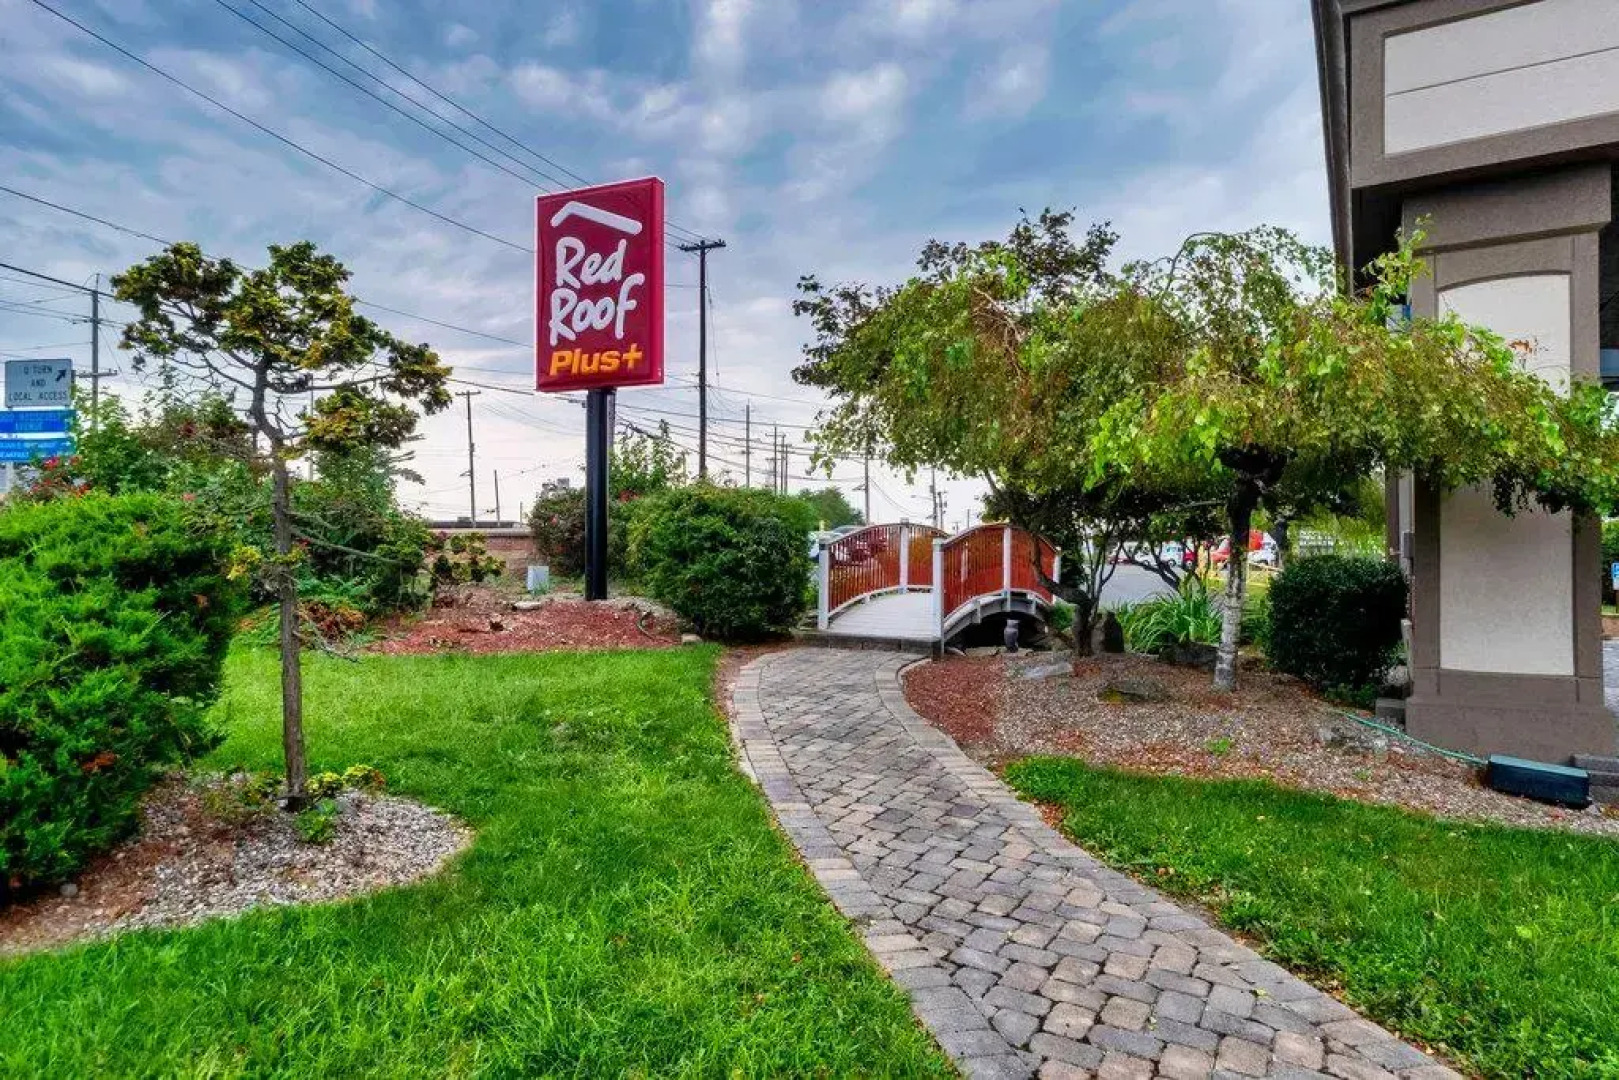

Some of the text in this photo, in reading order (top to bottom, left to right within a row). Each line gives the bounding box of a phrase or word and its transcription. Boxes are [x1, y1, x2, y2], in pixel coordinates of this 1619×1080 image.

[556, 236, 627, 289] Red
[549, 273, 645, 346] Roof
[550, 343, 643, 376] Plus+
[9, 391, 67, 400] LOCAL ACCESS
[31, 379, 46, 387] AND
